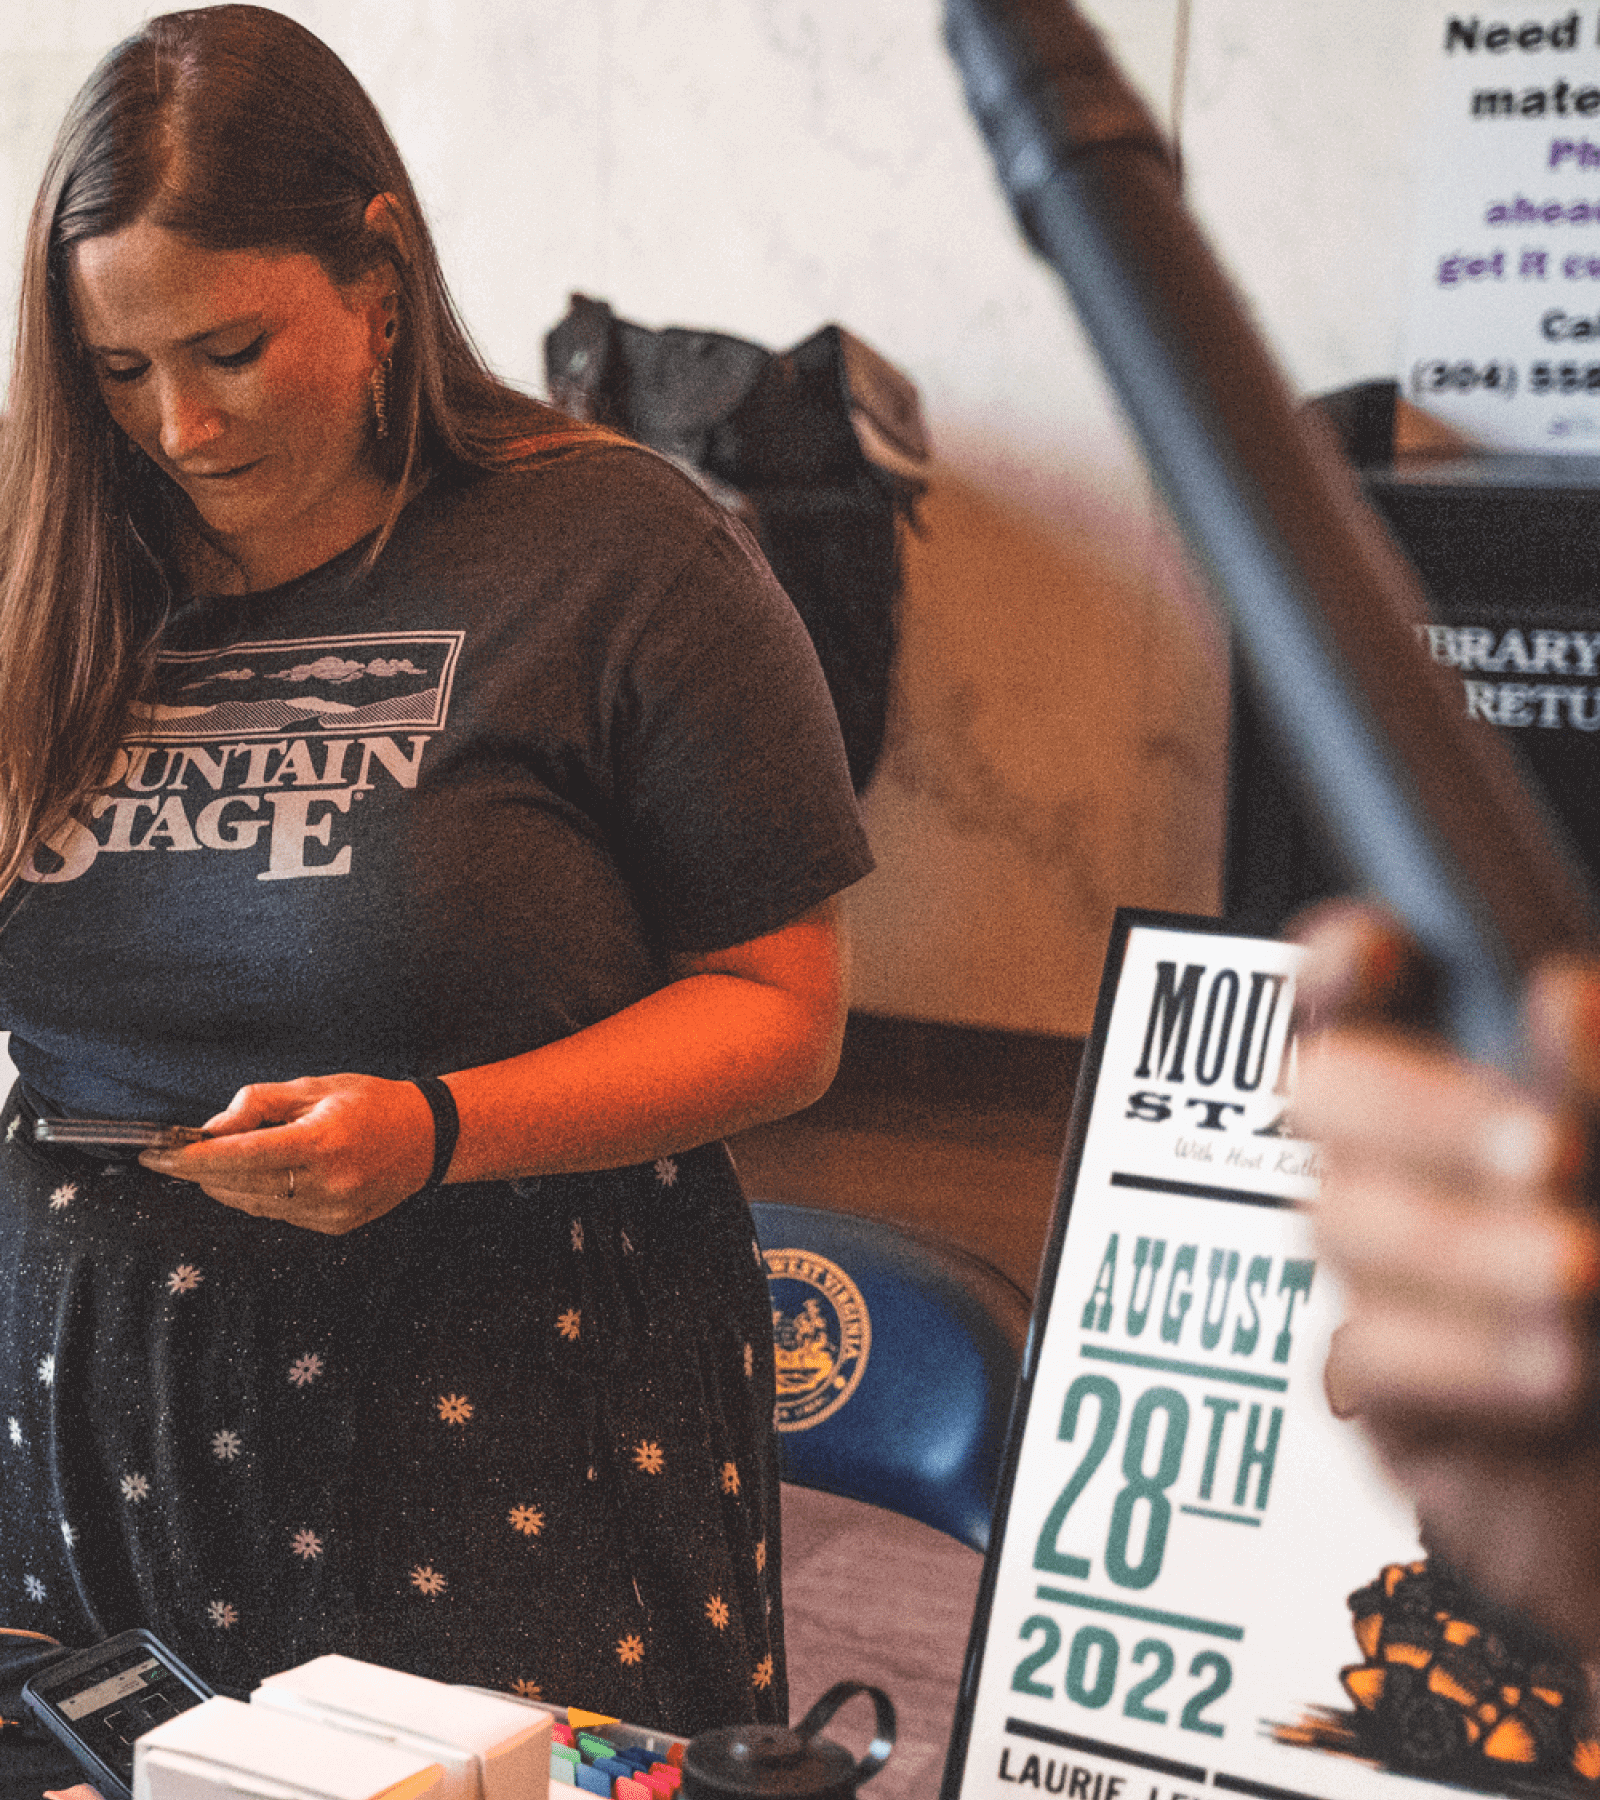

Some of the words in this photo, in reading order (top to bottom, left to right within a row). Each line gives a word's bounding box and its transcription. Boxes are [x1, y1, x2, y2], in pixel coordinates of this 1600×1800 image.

[1445, 12, 1579, 54] Need
[1470, 80, 1600, 119] mate
[1080, 1232, 1317, 1365] AUGUST
[1010, 1613, 1234, 1739] 2022
